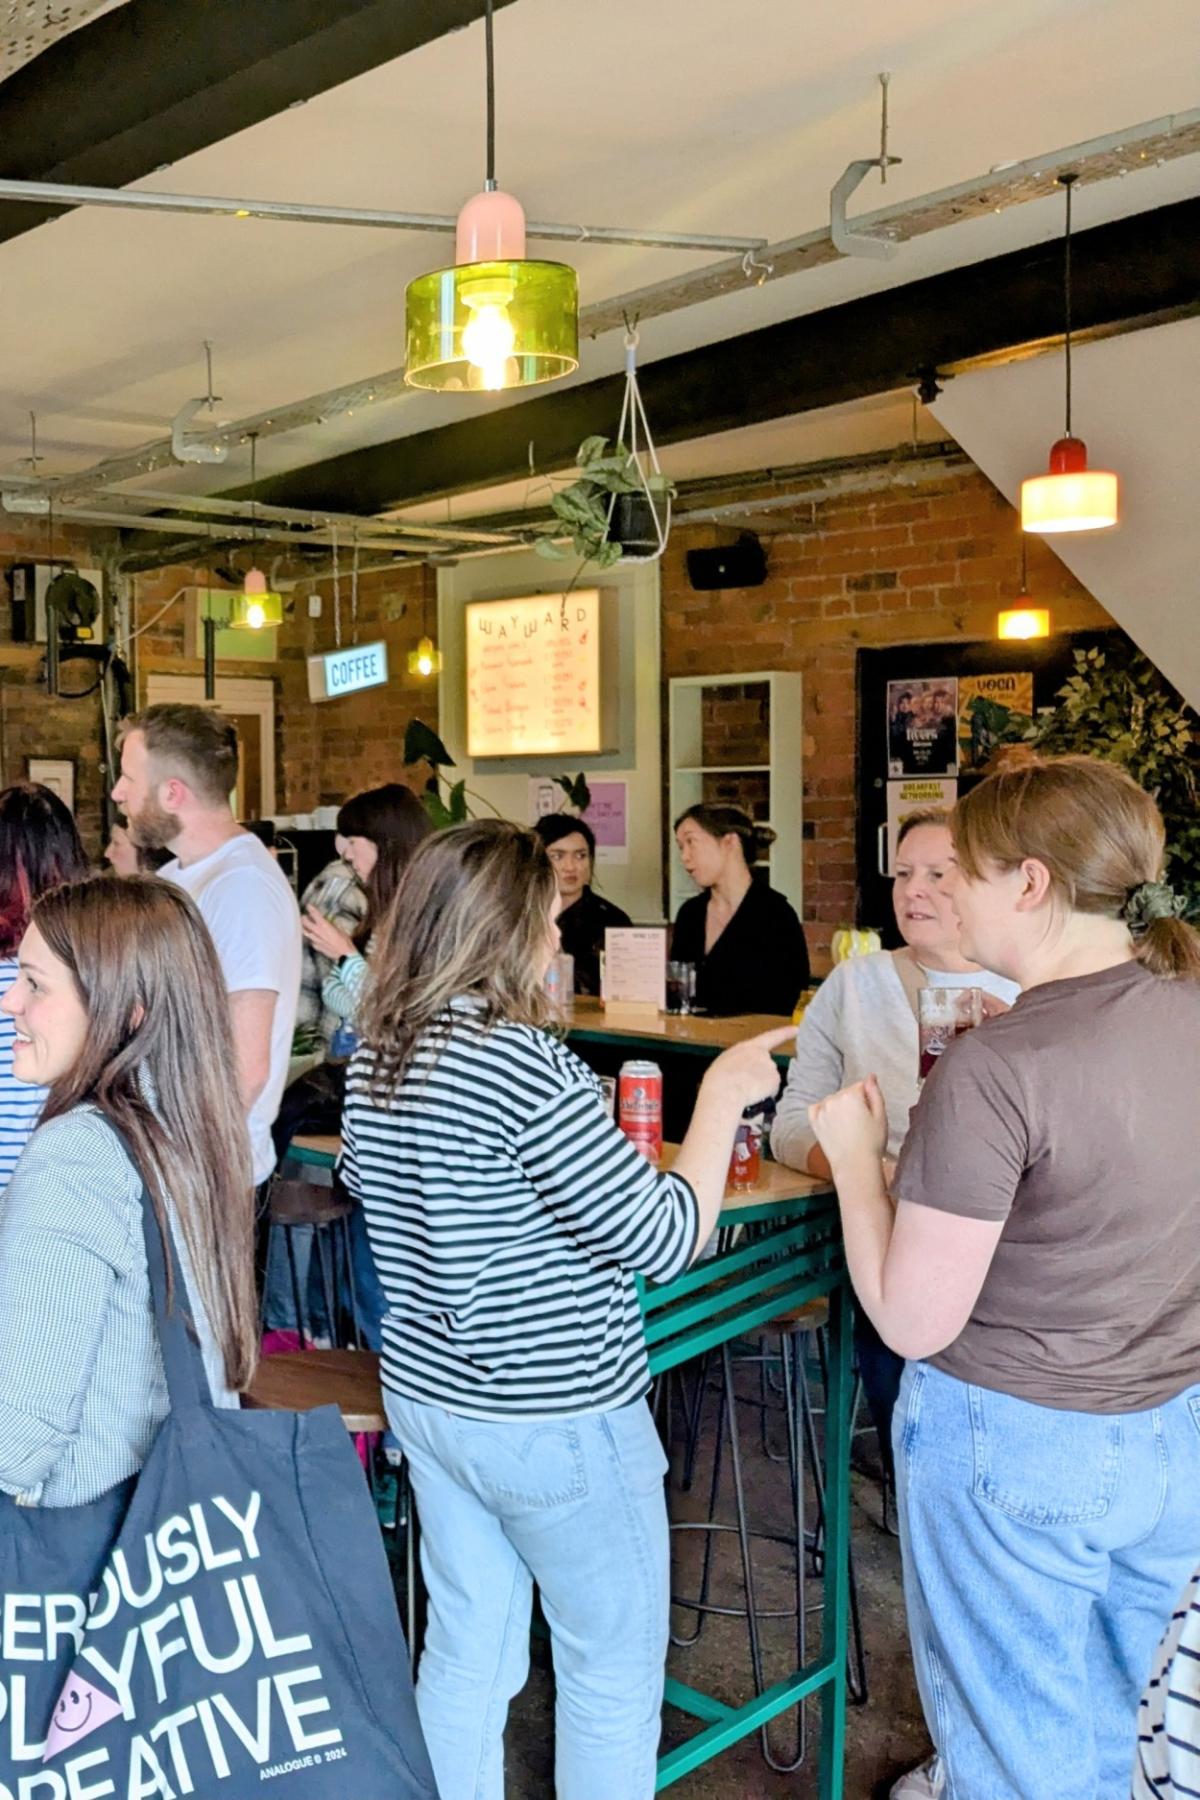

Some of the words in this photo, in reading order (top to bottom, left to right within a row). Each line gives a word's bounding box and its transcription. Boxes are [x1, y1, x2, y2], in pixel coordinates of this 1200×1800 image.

[479, 608, 587, 638] WAYWARD
[331, 652, 378, 687] COFFEE
[899, 791, 945, 800] NETWORKING
[260, 1755, 313, 1781] ANALOGUE
[324, 1747, 347, 1762] 2024
